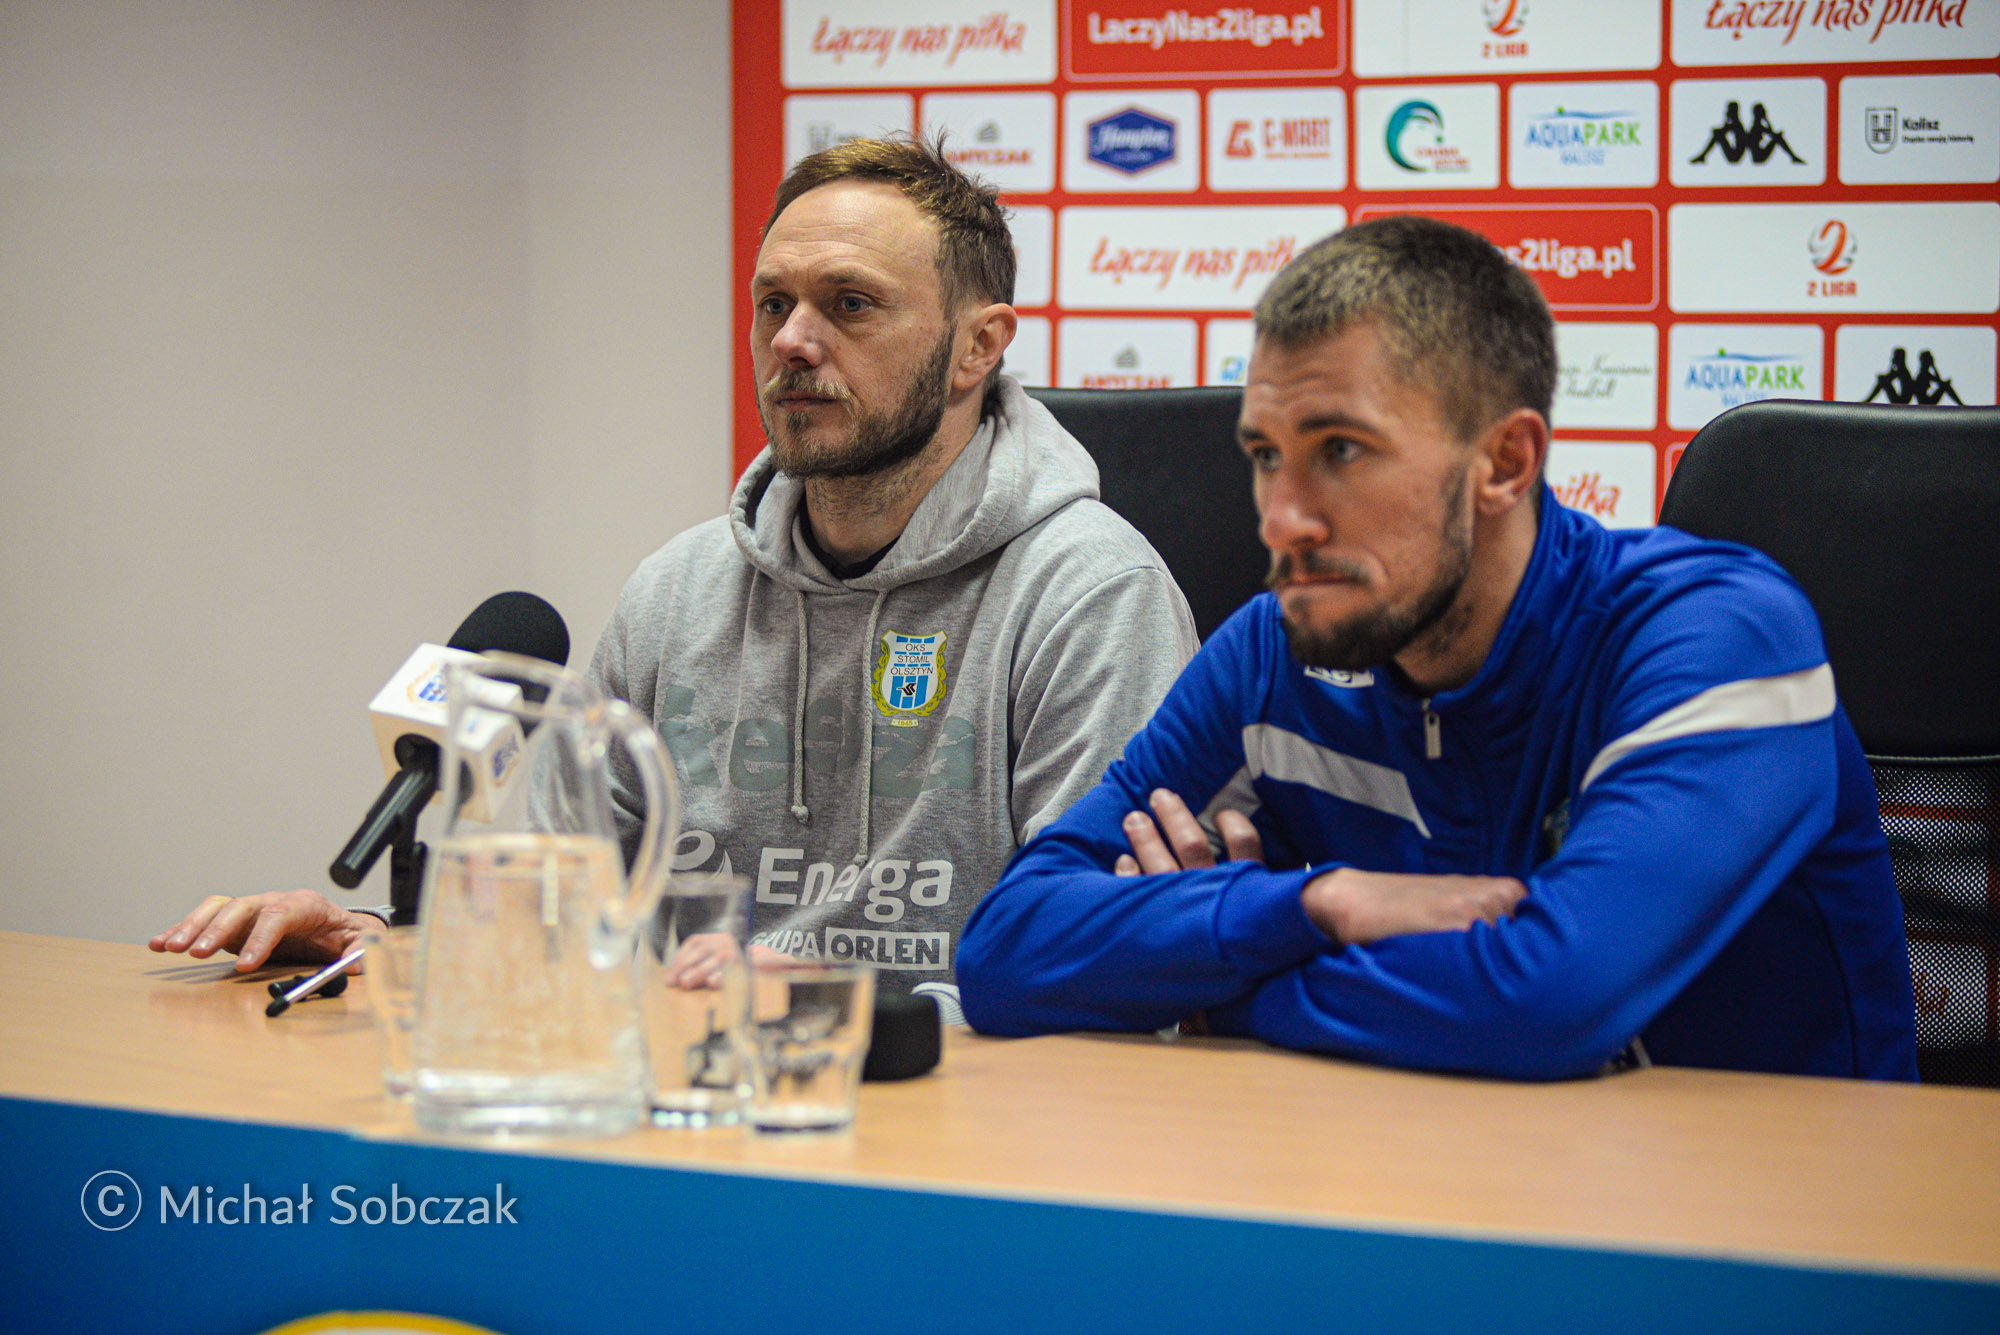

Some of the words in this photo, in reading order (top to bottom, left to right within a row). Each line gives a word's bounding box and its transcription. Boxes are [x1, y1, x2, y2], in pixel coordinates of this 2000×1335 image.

[1088, 6, 1324, 50] LaczyNas2liga.pl
[1810, 0, 1874, 32] nas
[813, 16, 896, 68] Łączy
[900, 24, 949, 53] nas
[946, 12, 1026, 68] piłka
[1482, 43, 1491, 58] 2
[1495, 42, 1529, 58] LIGA
[1526, 121, 1642, 148] AQUAPARK
[1090, 236, 1180, 291] Łączy
[1184, 248, 1237, 279] nas
[1231, 236, 1300, 292] pił
[1492, 238, 1636, 279] s2liga.pl
[1807, 281, 1817, 297] 2
[1821, 280, 1858, 297] LIGA
[1684, 364, 1805, 391] AQUAPARK
[897, 654, 931, 664] STOMIL
[905, 643, 926, 652] OKS
[890, 666, 934, 676] OLSZTYN
[755, 847, 954, 923] Energa
[830, 933, 941, 965] ORLEN
